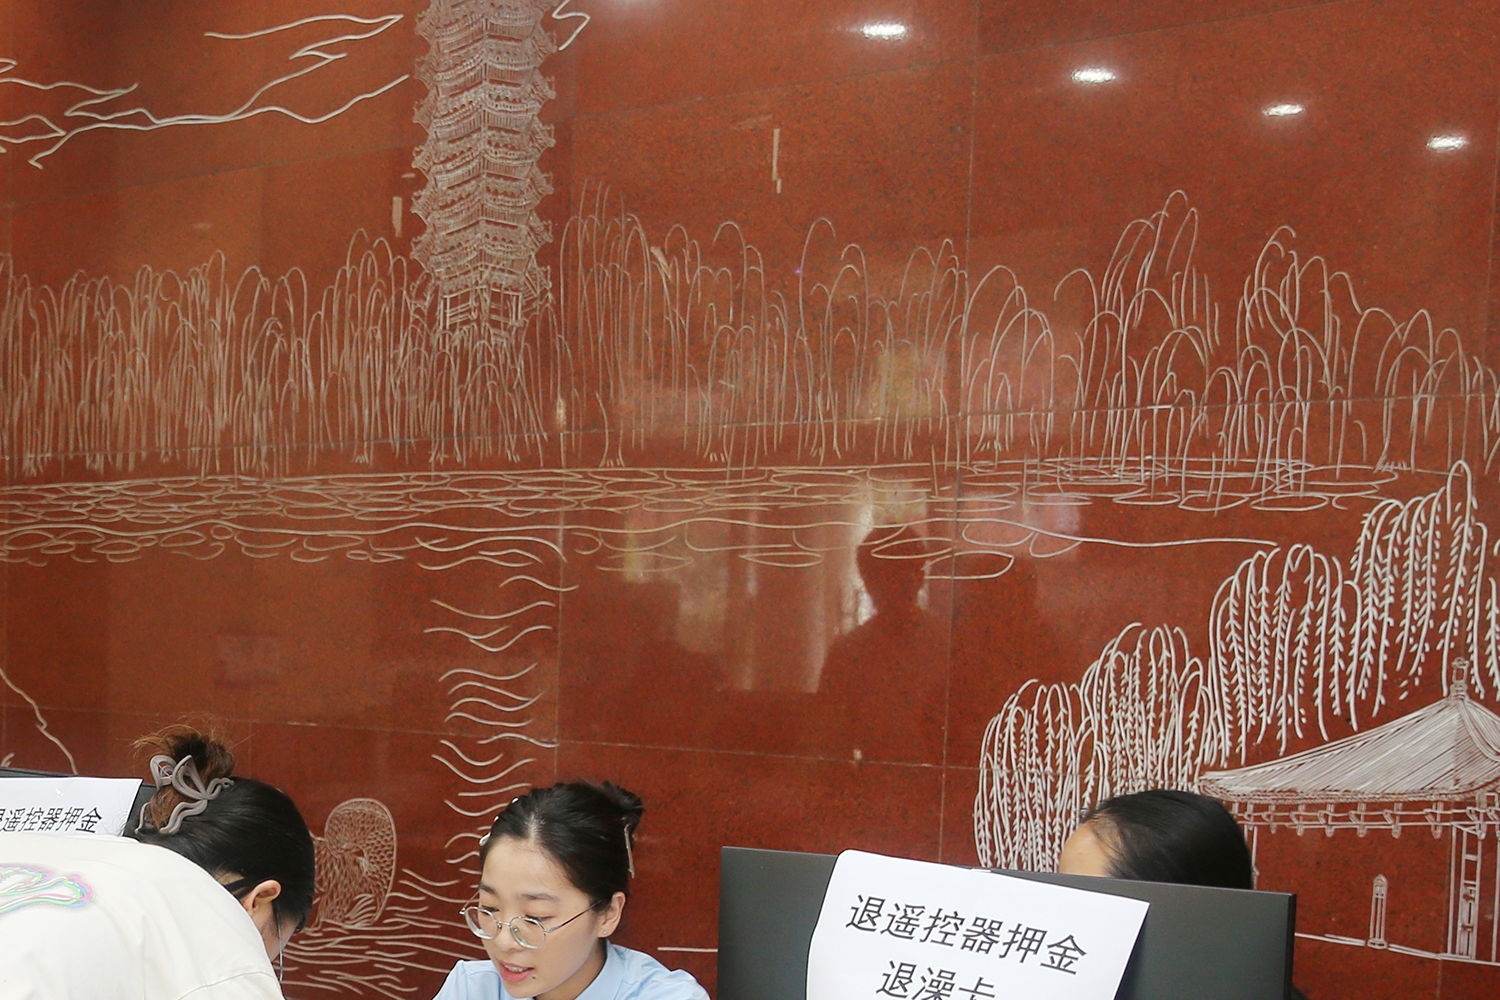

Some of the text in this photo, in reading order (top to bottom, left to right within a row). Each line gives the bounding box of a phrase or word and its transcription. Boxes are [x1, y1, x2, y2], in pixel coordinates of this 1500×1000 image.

[845, 894, 1088, 976] 退遥控器押金
